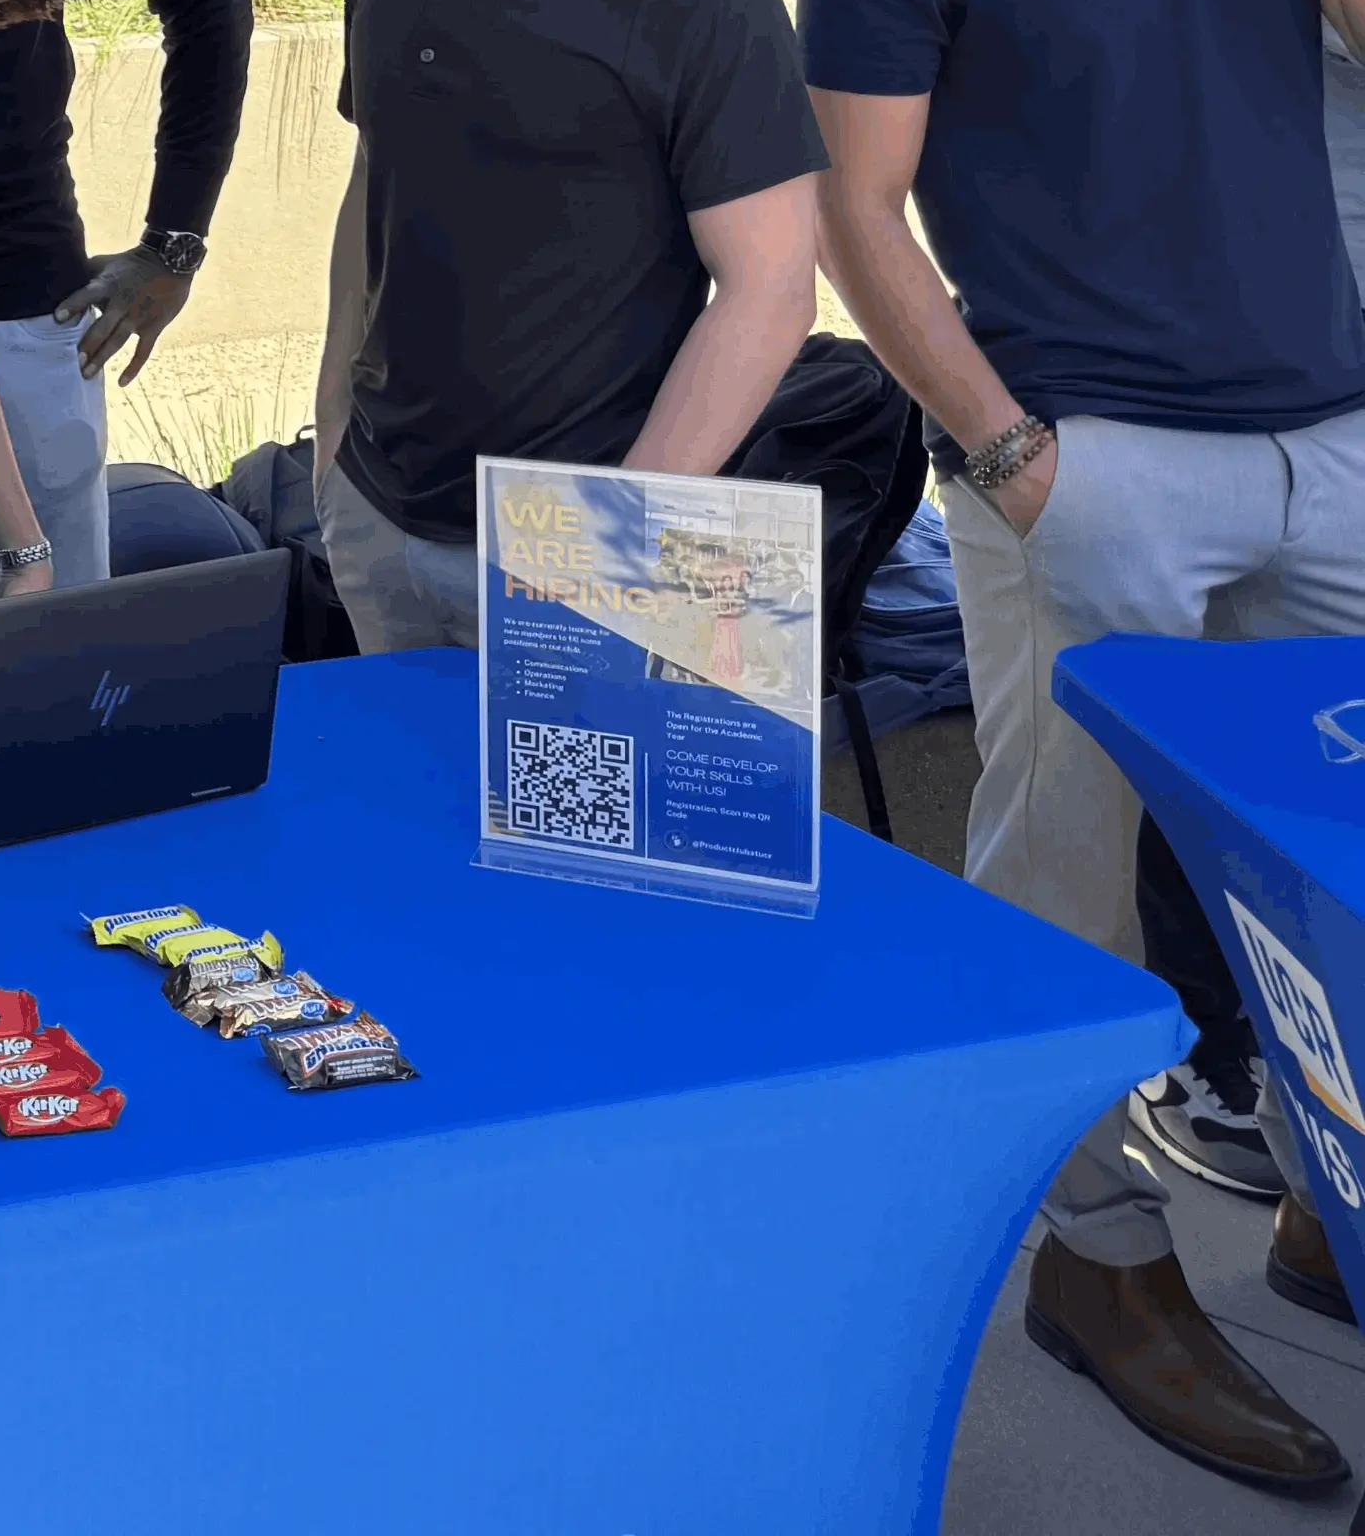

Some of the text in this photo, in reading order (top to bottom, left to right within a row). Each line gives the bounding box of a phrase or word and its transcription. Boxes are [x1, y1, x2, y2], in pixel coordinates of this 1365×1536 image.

[503, 499, 581, 533] WE
[504, 537, 595, 571] ARE
[505, 574, 659, 614] HIRING
[90, 670, 131, 727] hp
[666, 710, 681, 719] The
[683, 712, 741, 728] Registrations
[666, 721, 763, 741] Open for the Academic
[666, 732, 685, 741] Year
[666, 749, 778, 773] COME DEVELOP
[665, 763, 753, 786] YOUR SKILLS
[665, 779, 701, 793] WITH
[666, 809, 687, 820] Code
